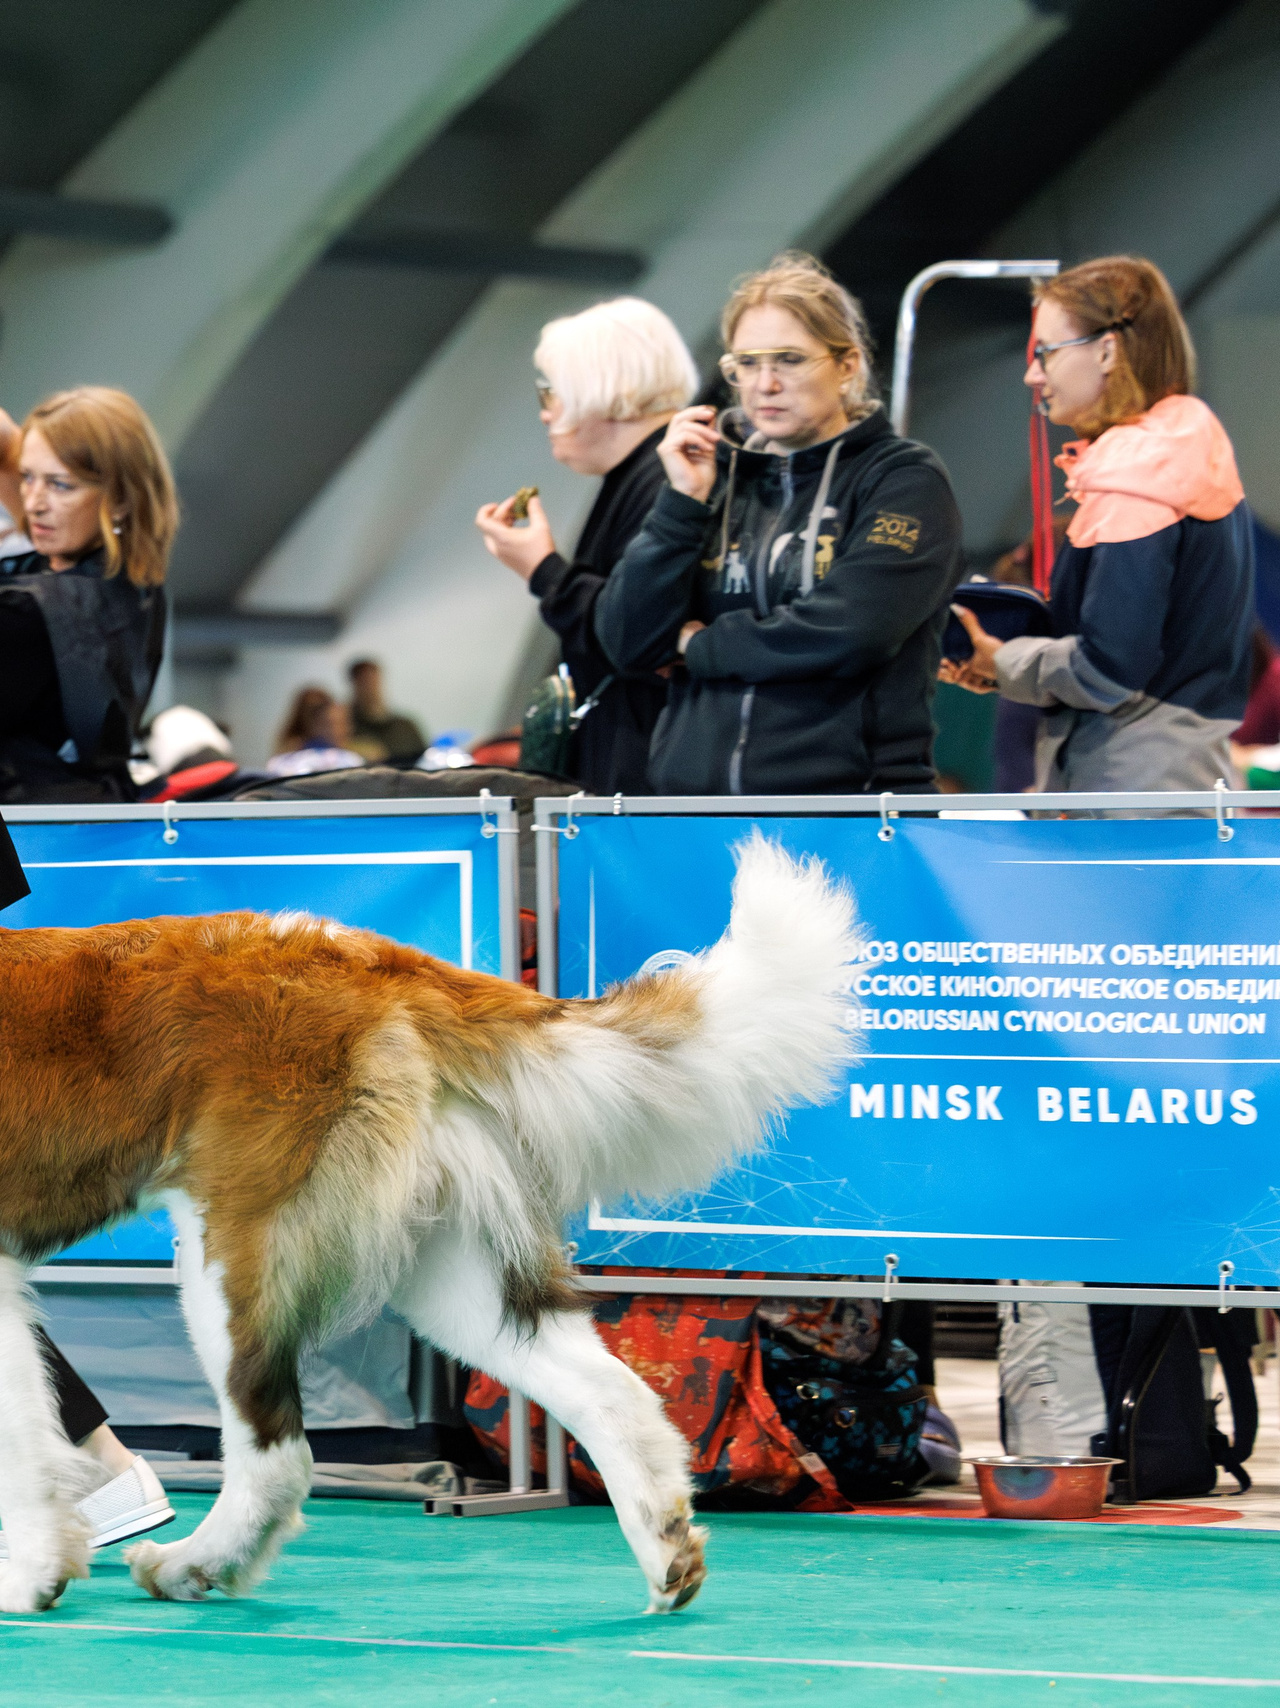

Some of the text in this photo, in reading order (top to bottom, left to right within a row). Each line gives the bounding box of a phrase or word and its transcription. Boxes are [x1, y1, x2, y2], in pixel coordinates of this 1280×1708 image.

[872, 517, 919, 542] 2014
[902, 941, 1106, 966] ОБЩЕСТВЕННЫХ
[940, 975, 1170, 1000] КИНОЛОГИЧЕСКОЕ
[1004, 1010, 1183, 1034] CYNOLOGICAL
[1187, 1012, 1266, 1035] UNION
[850, 1083, 1258, 1125] MINSK BELARUS
